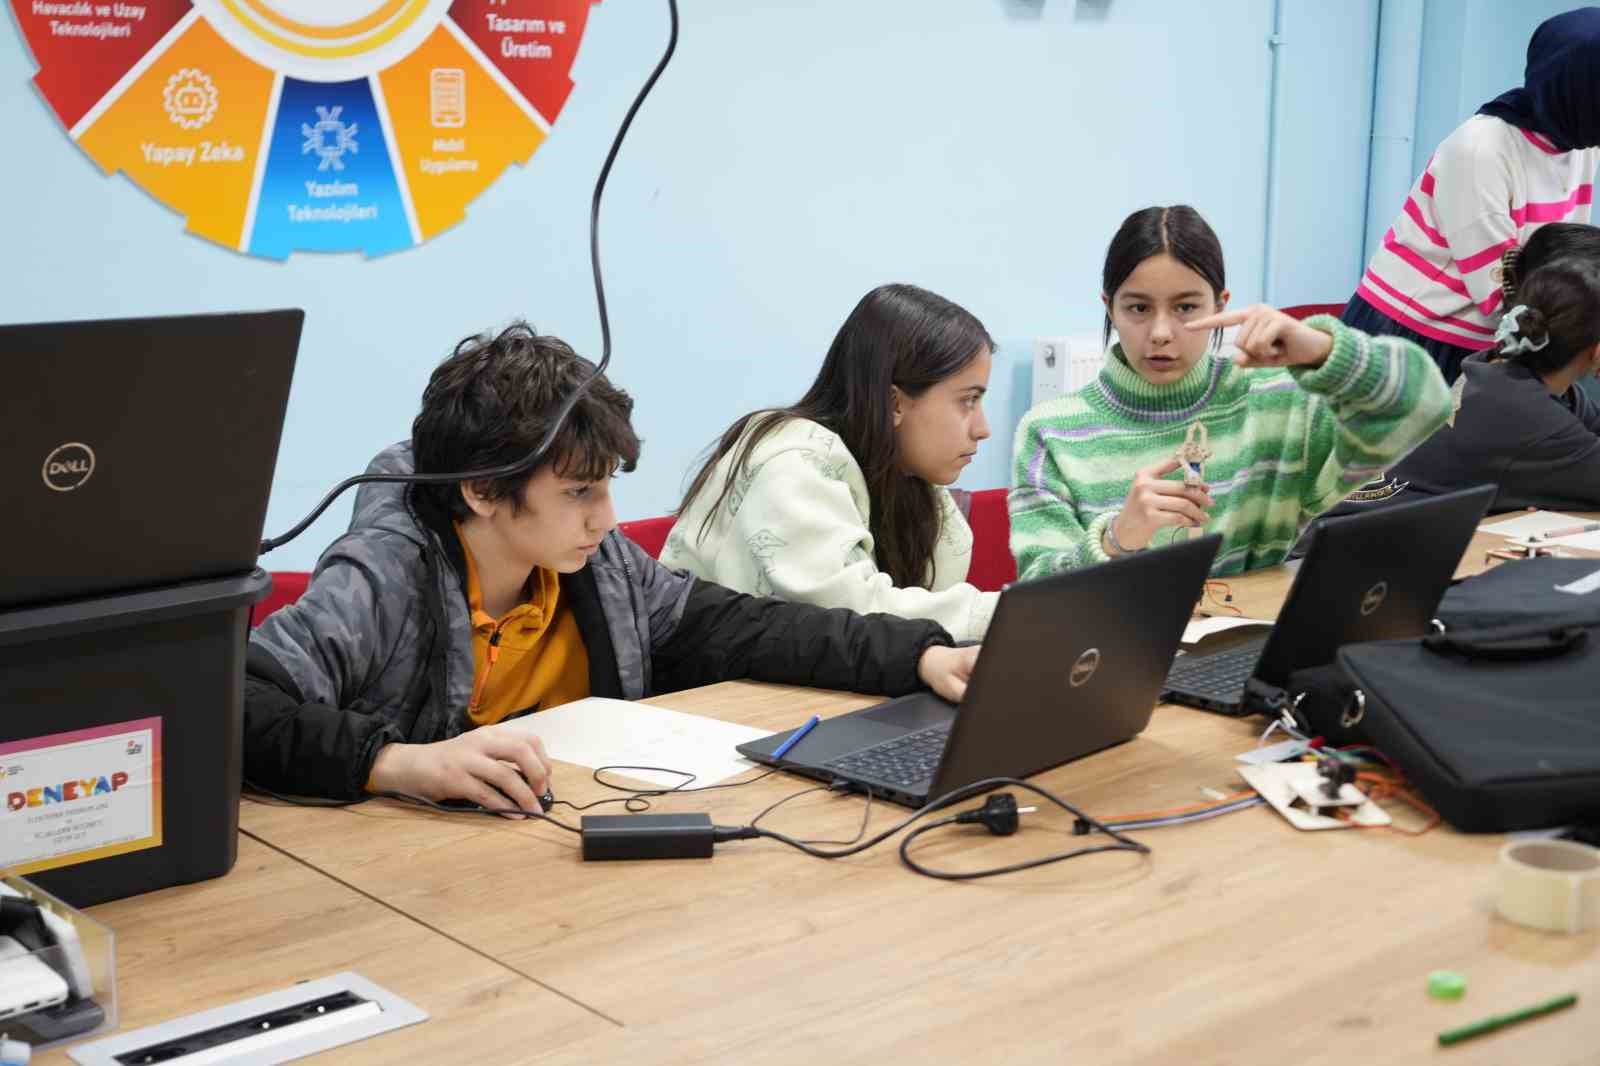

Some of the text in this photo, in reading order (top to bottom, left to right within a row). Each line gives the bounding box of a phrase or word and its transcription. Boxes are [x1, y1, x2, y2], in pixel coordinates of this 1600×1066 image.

[95, 5, 112, 17] ve
[113, 2, 146, 21] Uzay
[49, 20, 131, 40] Teknolojileri
[485, 12, 566, 34] Tasarım ve
[501, 35, 552, 58] Üretim
[140, 140, 246, 168] Yapay Zeka
[49, 459, 89, 475] DELL
[8, 771, 129, 812] DENEYAP
